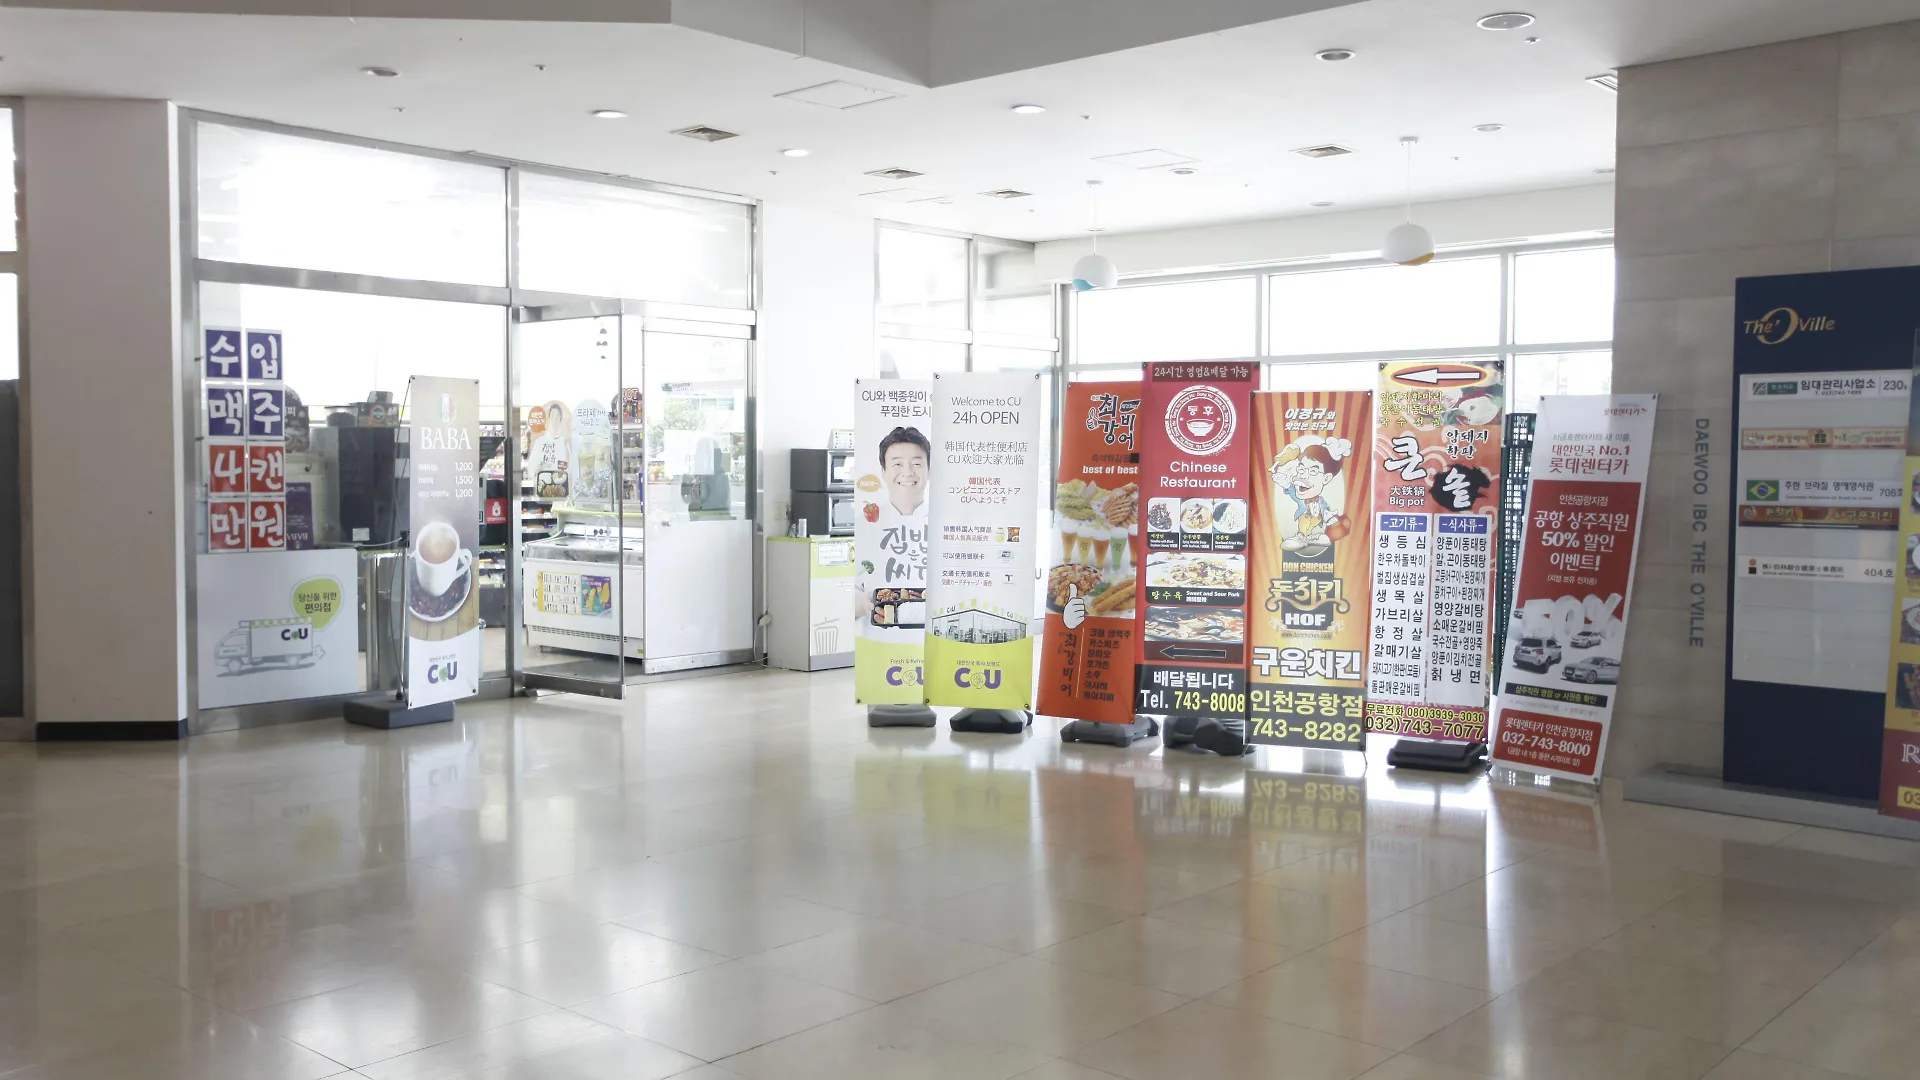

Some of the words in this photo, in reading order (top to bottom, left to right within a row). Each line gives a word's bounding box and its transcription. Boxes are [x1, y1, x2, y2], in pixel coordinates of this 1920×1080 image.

[210, 334, 278, 379] 수입
[1154, 365, 1184, 378] 24시간
[1186, 366, 1228, 378] 영업&배달
[1230, 366, 1249, 378] 가능
[1800, 378, 1876, 391] 임대관리사업소
[861, 390, 887, 402] CU와
[888, 390, 927, 402] 백종원이
[951, 396, 995, 406] Welcome
[996, 397, 1006, 406] to
[1007, 396, 1021, 406] CU
[209, 390, 281, 435] 맥주
[880, 405, 910, 418] 푸짐한
[952, 411, 978, 425] 24h
[980, 411, 1020, 425] OPEN
[1284, 407, 1336, 420] 이경규와
[1284, 421, 1309, 431] 맛있는
[421, 426, 472, 450] BABA
[1447, 429, 1489, 444] 암돼지
[944, 440, 1028, 453] 韩国代表性便利店
[1447, 445, 1476, 459] 한판
[1551, 444, 1596, 457] 대한민국
[1598, 444, 1631, 456] No.1
[947, 453, 1024, 466] CU欢迎大家光临
[1383, 435, 1428, 481] 큰
[1692, 418, 1710, 495] DAEWOO
[213, 450, 283, 490] 4캔
[455, 462, 474, 472] 1,200
[1082, 465, 1103, 474] best
[1105, 465, 1114, 474] of
[1116, 465, 1139, 475] best
[1169, 461, 1227, 473] Chinese
[1549, 457, 1631, 475] 롯데렌터카
[455, 476, 474, 485] 1,500
[968, 476, 1001, 486] 韓国代表
[1160, 476, 1237, 489] Restaurant
[1784, 481, 1801, 491] 주한
[1804, 481, 1829, 491] 브라질
[455, 489, 474, 499] 1,200
[948, 486, 1021, 495] コンビニエンスストア
[1390, 485, 1426, 497] 大铁锅
[960, 495, 1008, 504] CUへようこそ
[1389, 497, 1405, 507] Big
[1407, 498, 1425, 507] pot
[1559, 494, 1609, 507] 인천공항지점
[210, 502, 285, 548] 만원
[1533, 510, 1565, 529] 공항
[1566, 511, 1631, 532] 상주직원
[1691, 504, 1708, 533] IBC
[1436, 536, 1488, 552] 양푼이동태탕
[1541, 531, 1581, 548] 50%
[1583, 533, 1615, 553] 할인
[1550, 552, 1602, 572] 이벤트!
[1690, 541, 1706, 575] THE
[1282, 561, 1299, 573] DON
[1300, 562, 1334, 574] CHICKEN
[1863, 568, 1894, 579] 404호
[298, 593, 319, 603] 당신을
[322, 591, 337, 602] 위한
[1376, 589, 1425, 605] 생목살
[304, 601, 332, 614] 편의점
[1375, 607, 1424, 623] 가브리살
[1434, 602, 1485, 618] 영양갈비탕
[1284, 612, 1326, 626] HOF
[1688, 583, 1705, 648] O'VILLE
[1374, 625, 1423, 642] 항정살
[1432, 618, 1483, 635] 소매운갈비찜
[280, 628, 309, 641] CU
[1374, 643, 1422, 660] 갈매기살
[1252, 646, 1363, 681] 구운치킨
[427, 660, 458, 685] CU
[954, 667, 1002, 690] CU
[1153, 670, 1235, 690] 배달됩니다
[1140, 689, 1169, 709] Tel.
[1174, 690, 1245, 713] 743-8008
[1250, 689, 1363, 718] 인천공항점
[1366, 703, 1405, 717] 무료전화
[1407, 706, 1485, 724] 080)3939-3030
[1250, 717, 1361, 743] 743-8282
[1365, 716, 1485, 740] 032)743-7077
[1505, 717, 1544, 732] 롯데렌터카
[1545, 723, 1594, 741] 인천공항지점
[1502, 730, 1592, 757] 032-743-8000
